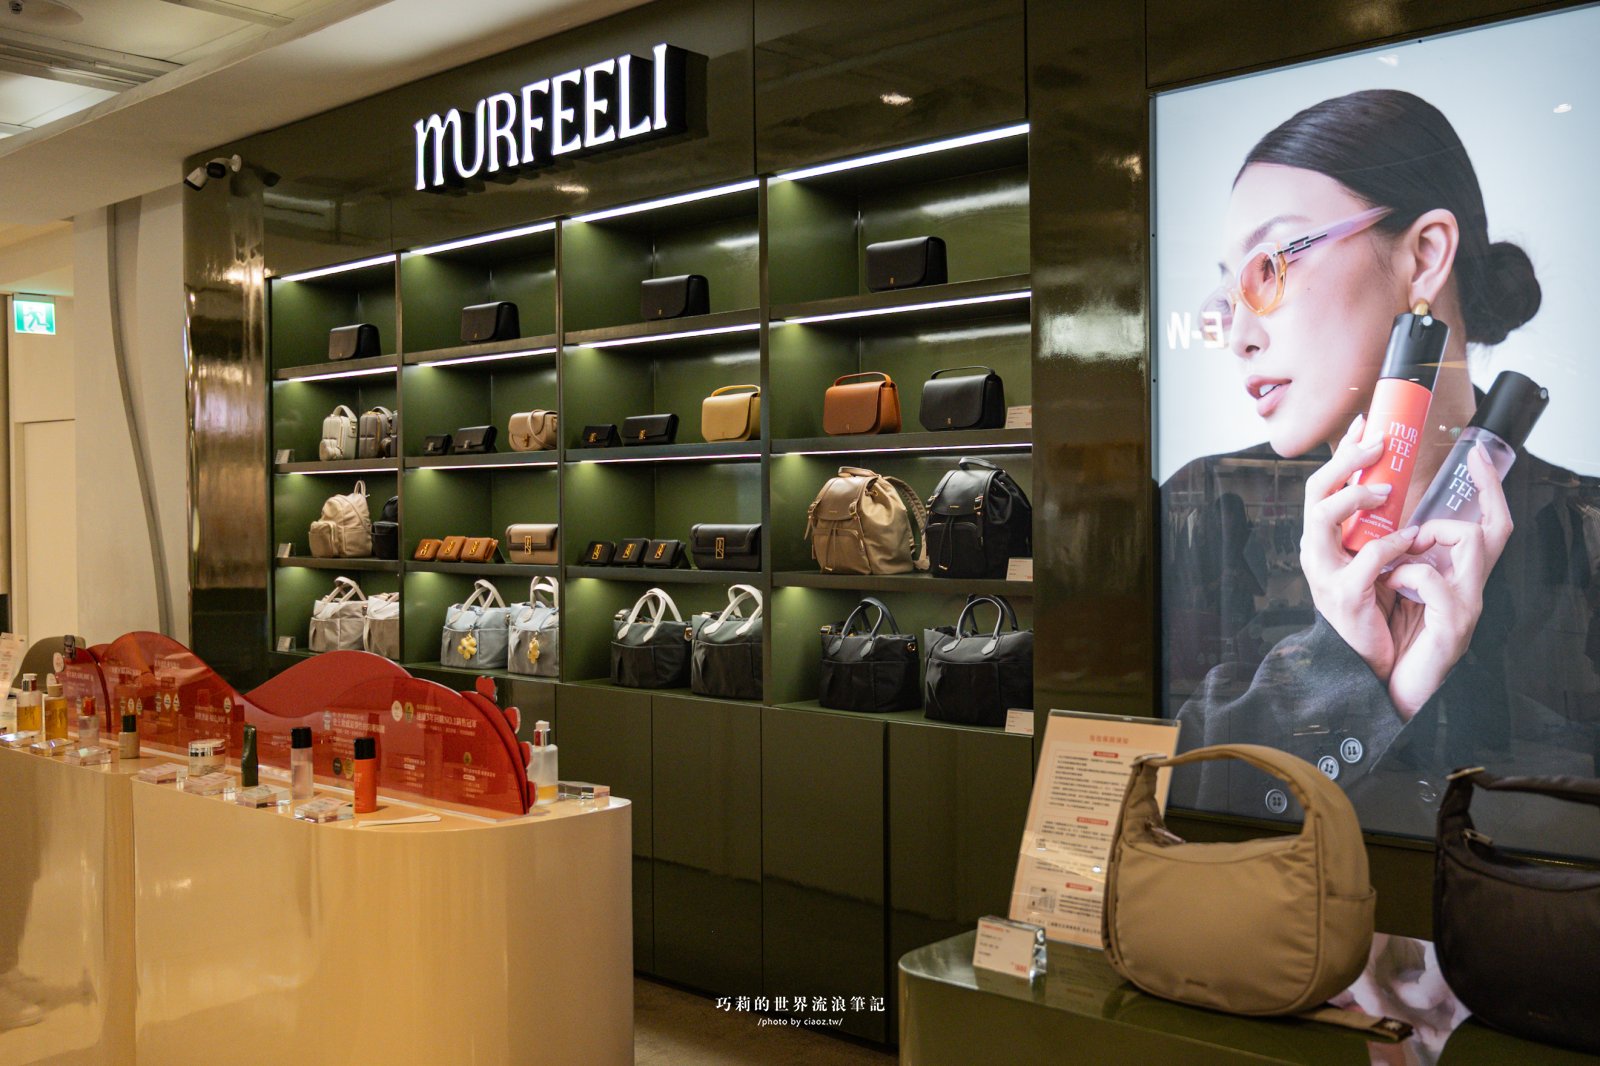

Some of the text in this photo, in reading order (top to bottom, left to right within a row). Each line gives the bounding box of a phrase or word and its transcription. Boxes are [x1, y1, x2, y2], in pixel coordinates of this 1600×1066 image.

[1388, 437, 1413, 458] FEE
[1390, 455, 1404, 472] LI
[1449, 477, 1477, 501] FEE
[1445, 494, 1463, 511] LI
